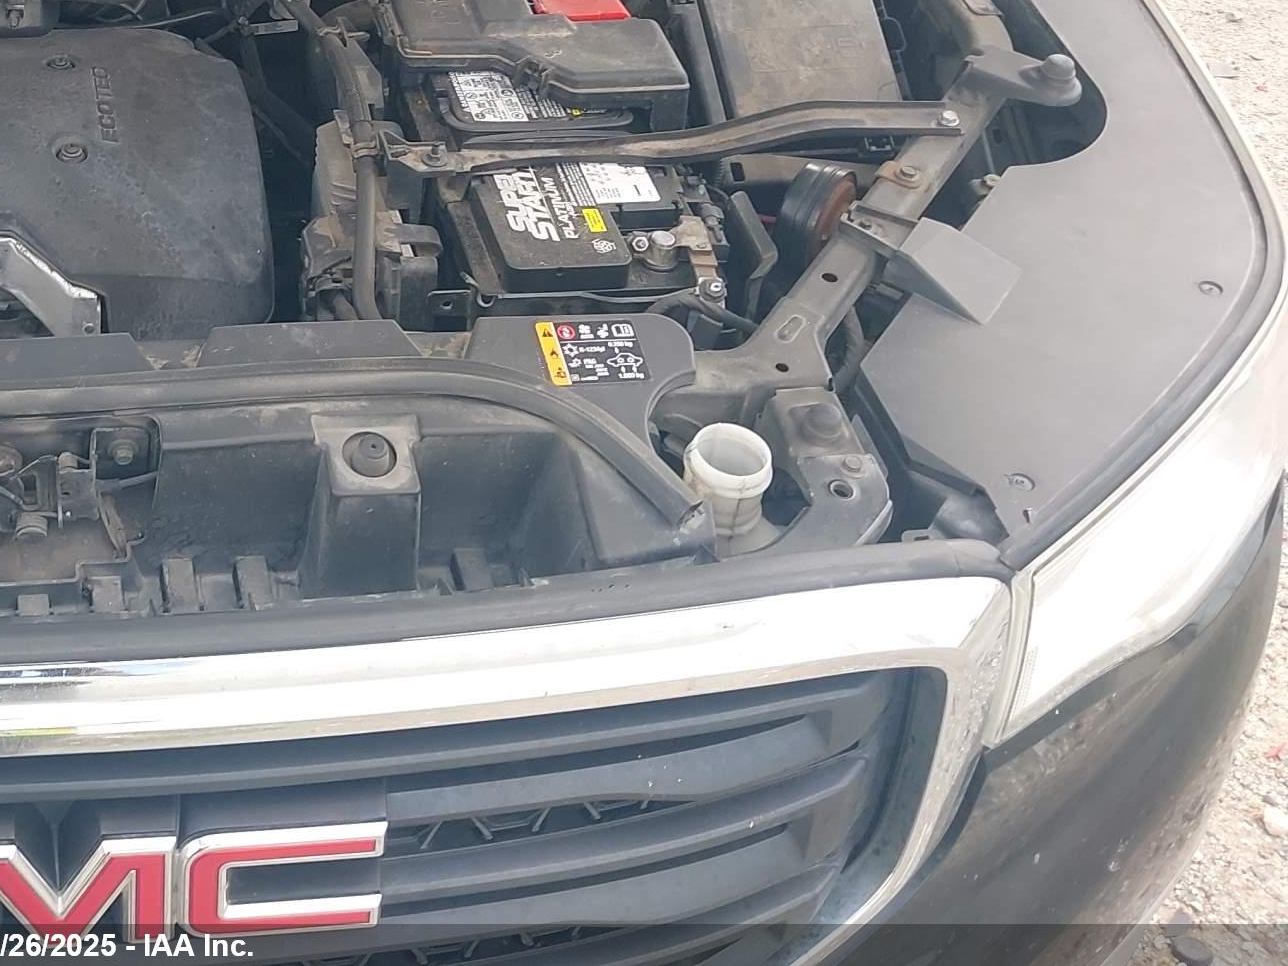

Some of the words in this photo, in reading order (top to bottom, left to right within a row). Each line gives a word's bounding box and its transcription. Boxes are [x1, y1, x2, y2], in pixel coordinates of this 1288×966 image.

[92, 66, 119, 144] ECOTEC
[493, 174, 526, 232] SUPE
[541, 176, 579, 239] PLATINUM
